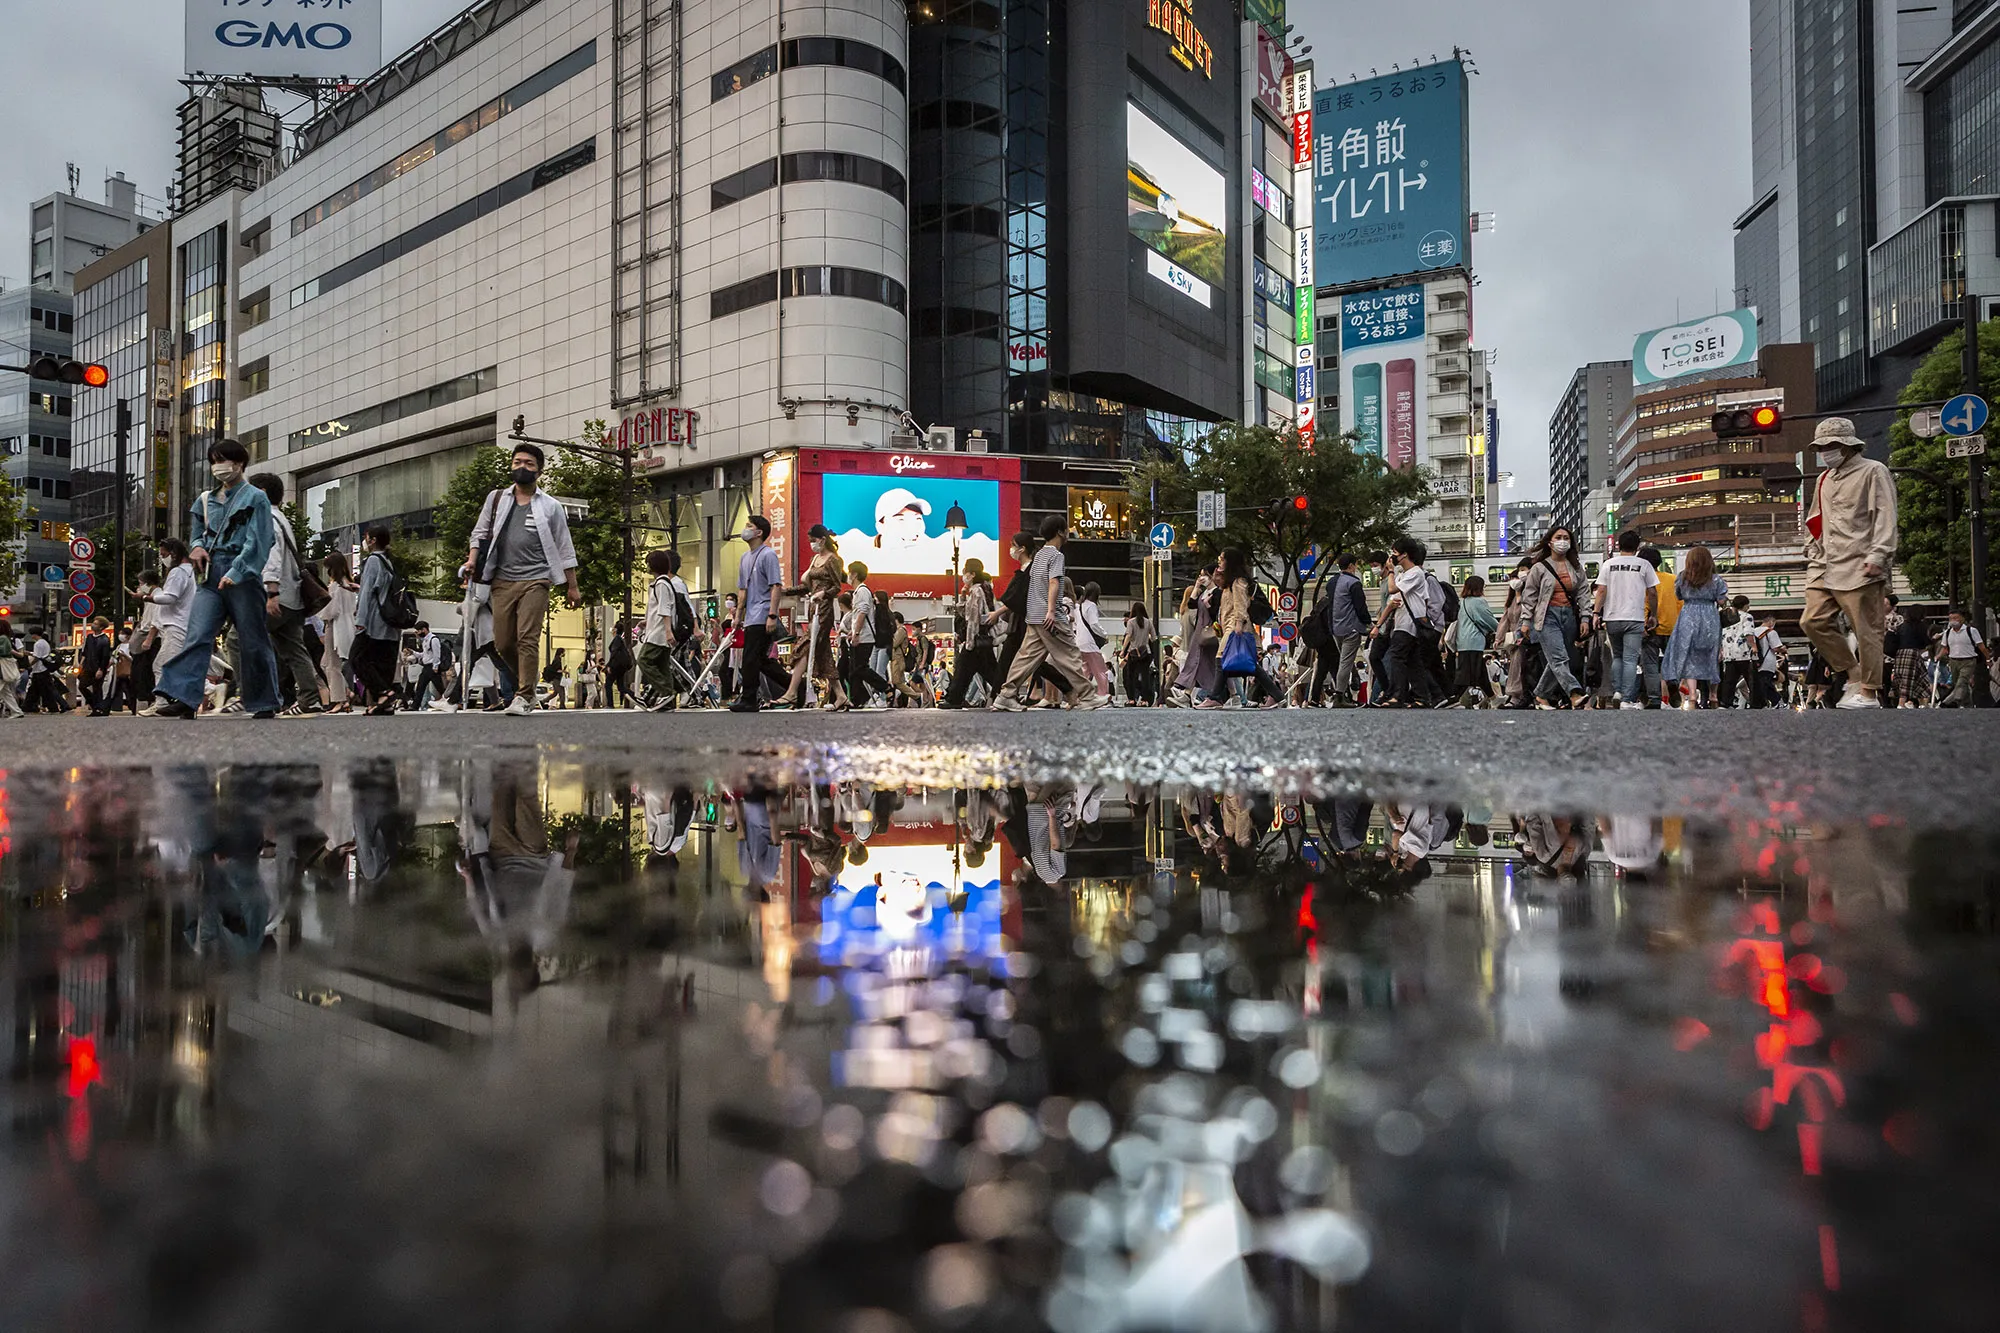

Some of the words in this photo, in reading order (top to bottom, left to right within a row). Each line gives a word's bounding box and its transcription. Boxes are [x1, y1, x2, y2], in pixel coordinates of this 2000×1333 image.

[215, 20, 351, 50] GMO
[1149, 0, 1213, 80] MAGNET
[1298, 124, 1309, 162] アイフル
[1314, 168, 1428, 224] イレクト
[1421, 239, 1453, 259] 生薬
[1177, 271, 1193, 293] Sky
[1345, 292, 1420, 315] 水なしで飲む
[1351, 308, 1414, 327] のど、直接、
[1358, 322, 1408, 341] うるおう
[1661, 334, 1725, 361] TOSEI
[1662, 350, 1725, 371] トーセイ株式会社
[890, 455, 936, 474] Glico
[1433, 480, 1460, 489] DARTS
[1079, 519, 1116, 529] COFFEE
[1764, 575, 1792, 597] 駅
